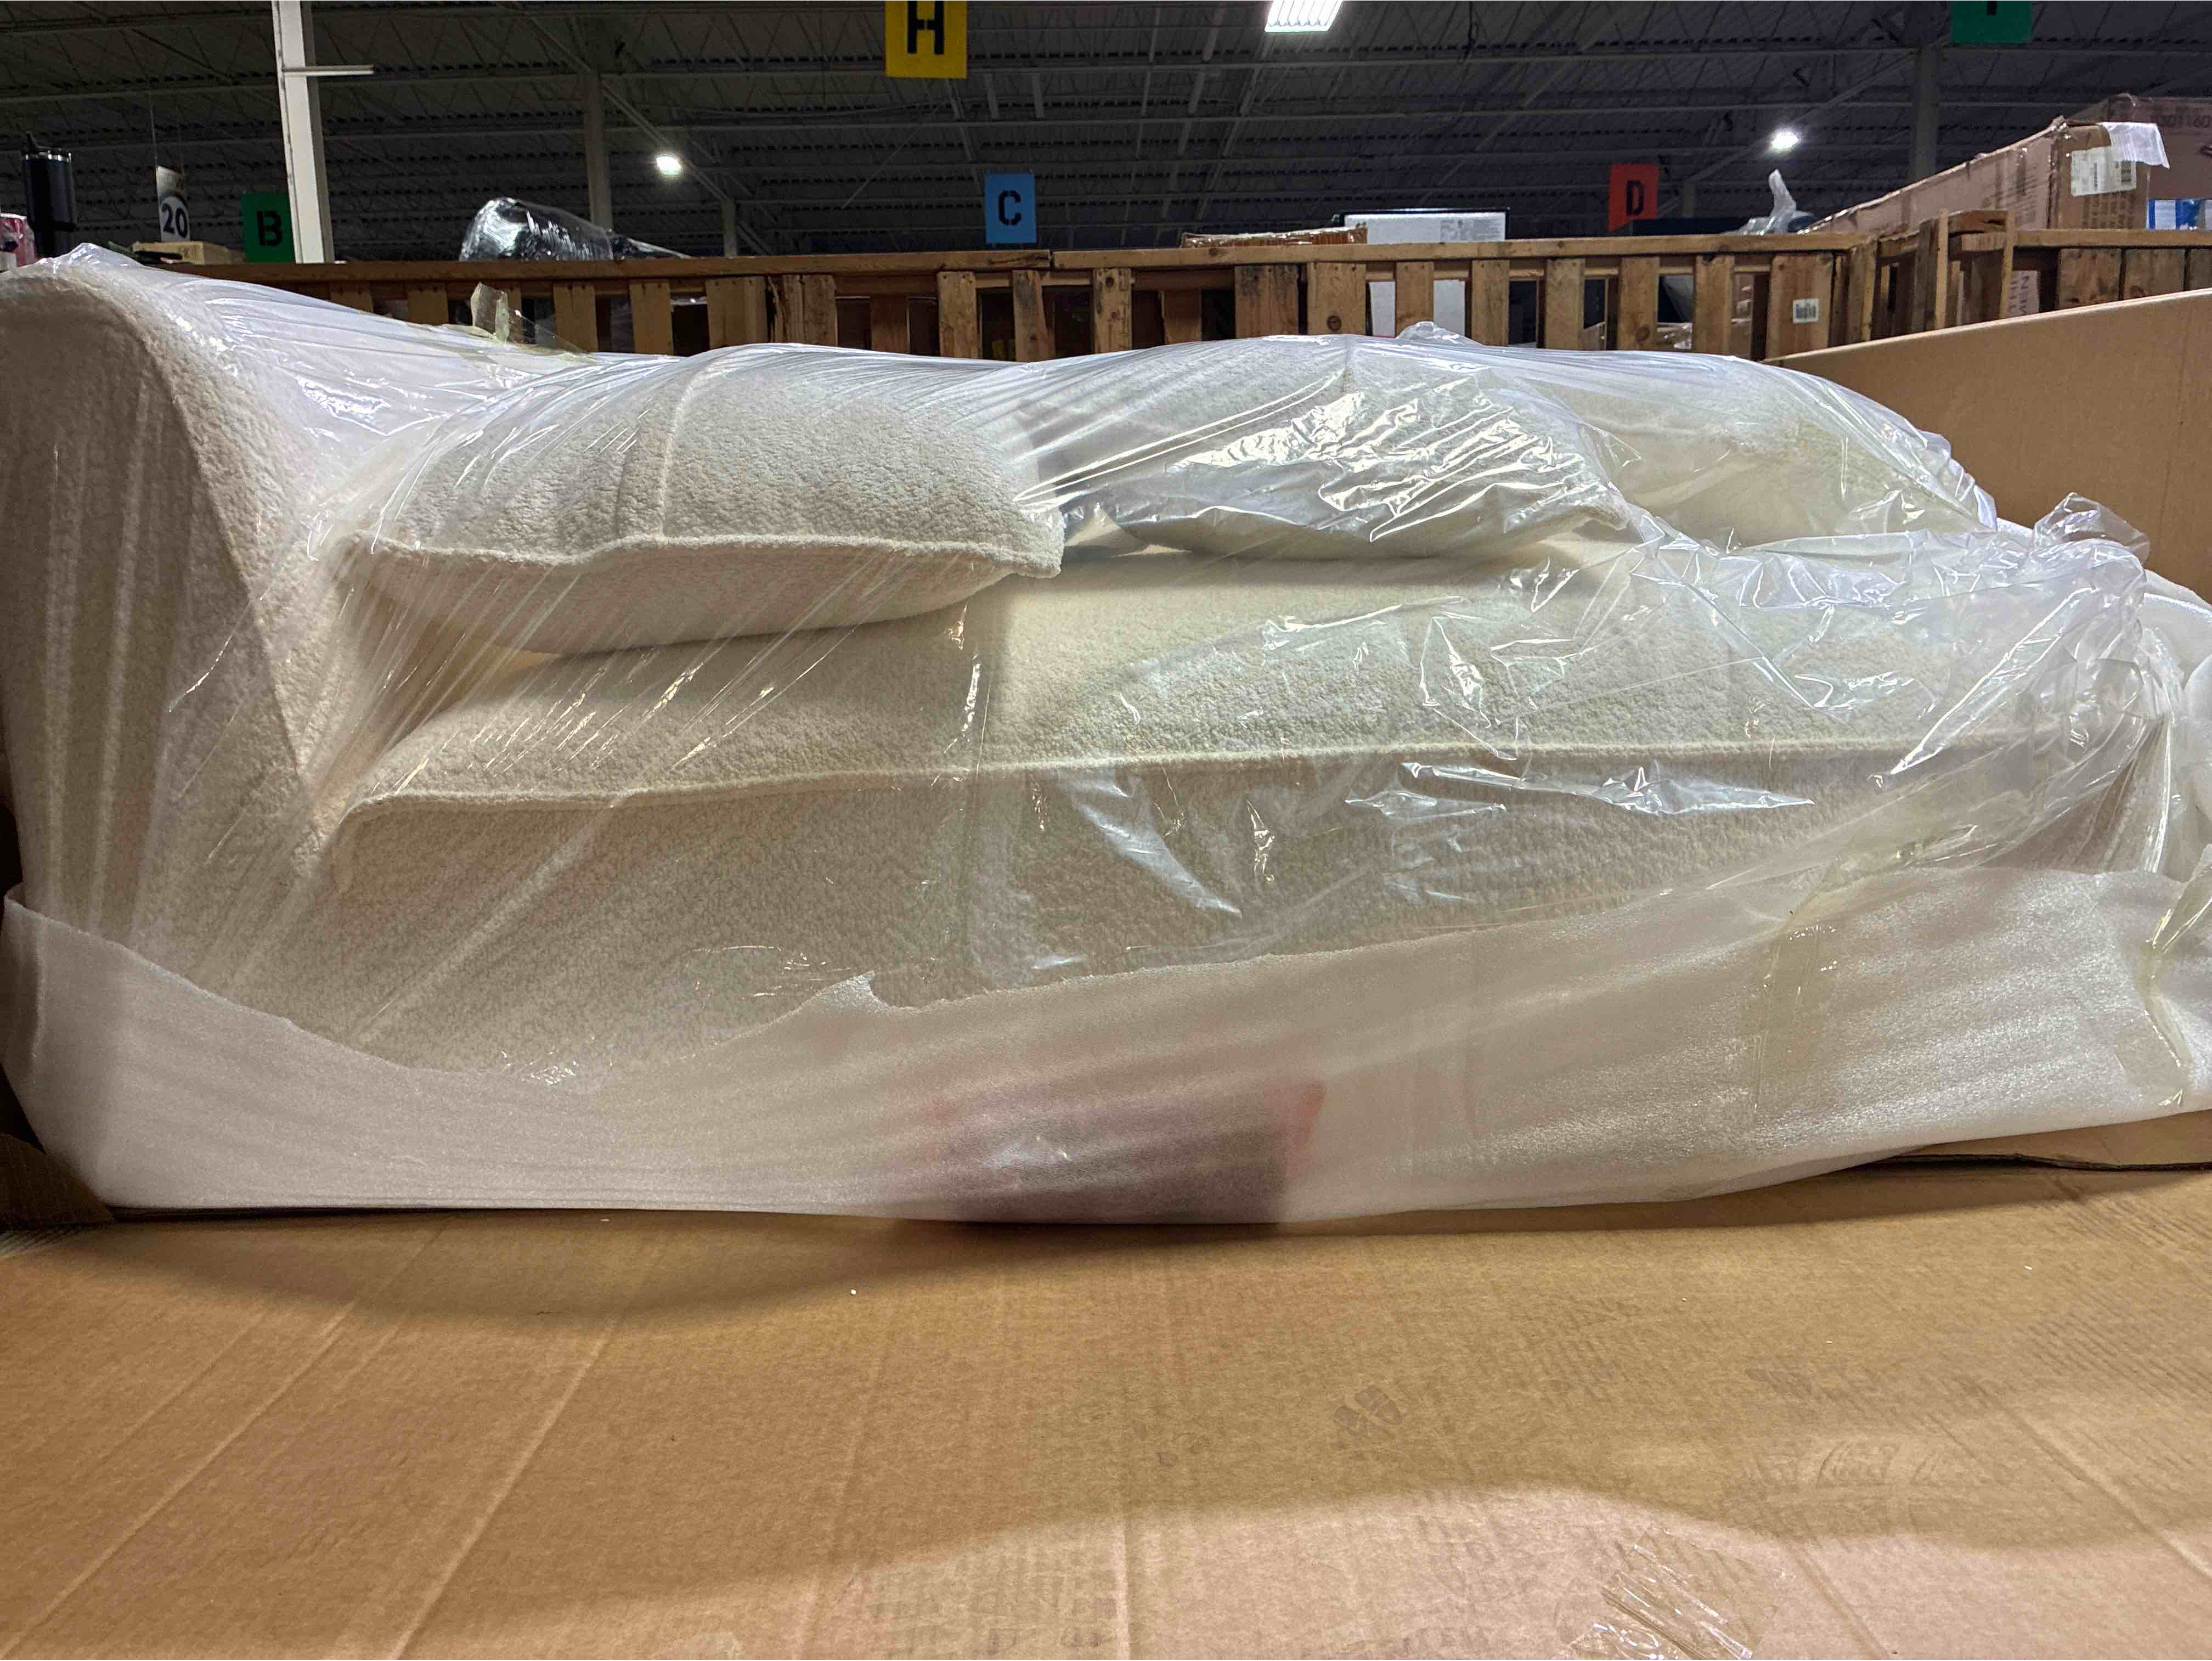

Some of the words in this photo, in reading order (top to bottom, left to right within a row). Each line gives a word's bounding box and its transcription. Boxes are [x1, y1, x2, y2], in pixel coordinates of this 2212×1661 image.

[907, 0, 944, 54] H
[997, 190, 1022, 226] C
[1626, 180, 1645, 216] D
[161, 202, 188, 238] 20
[257, 211, 283, 247] B
